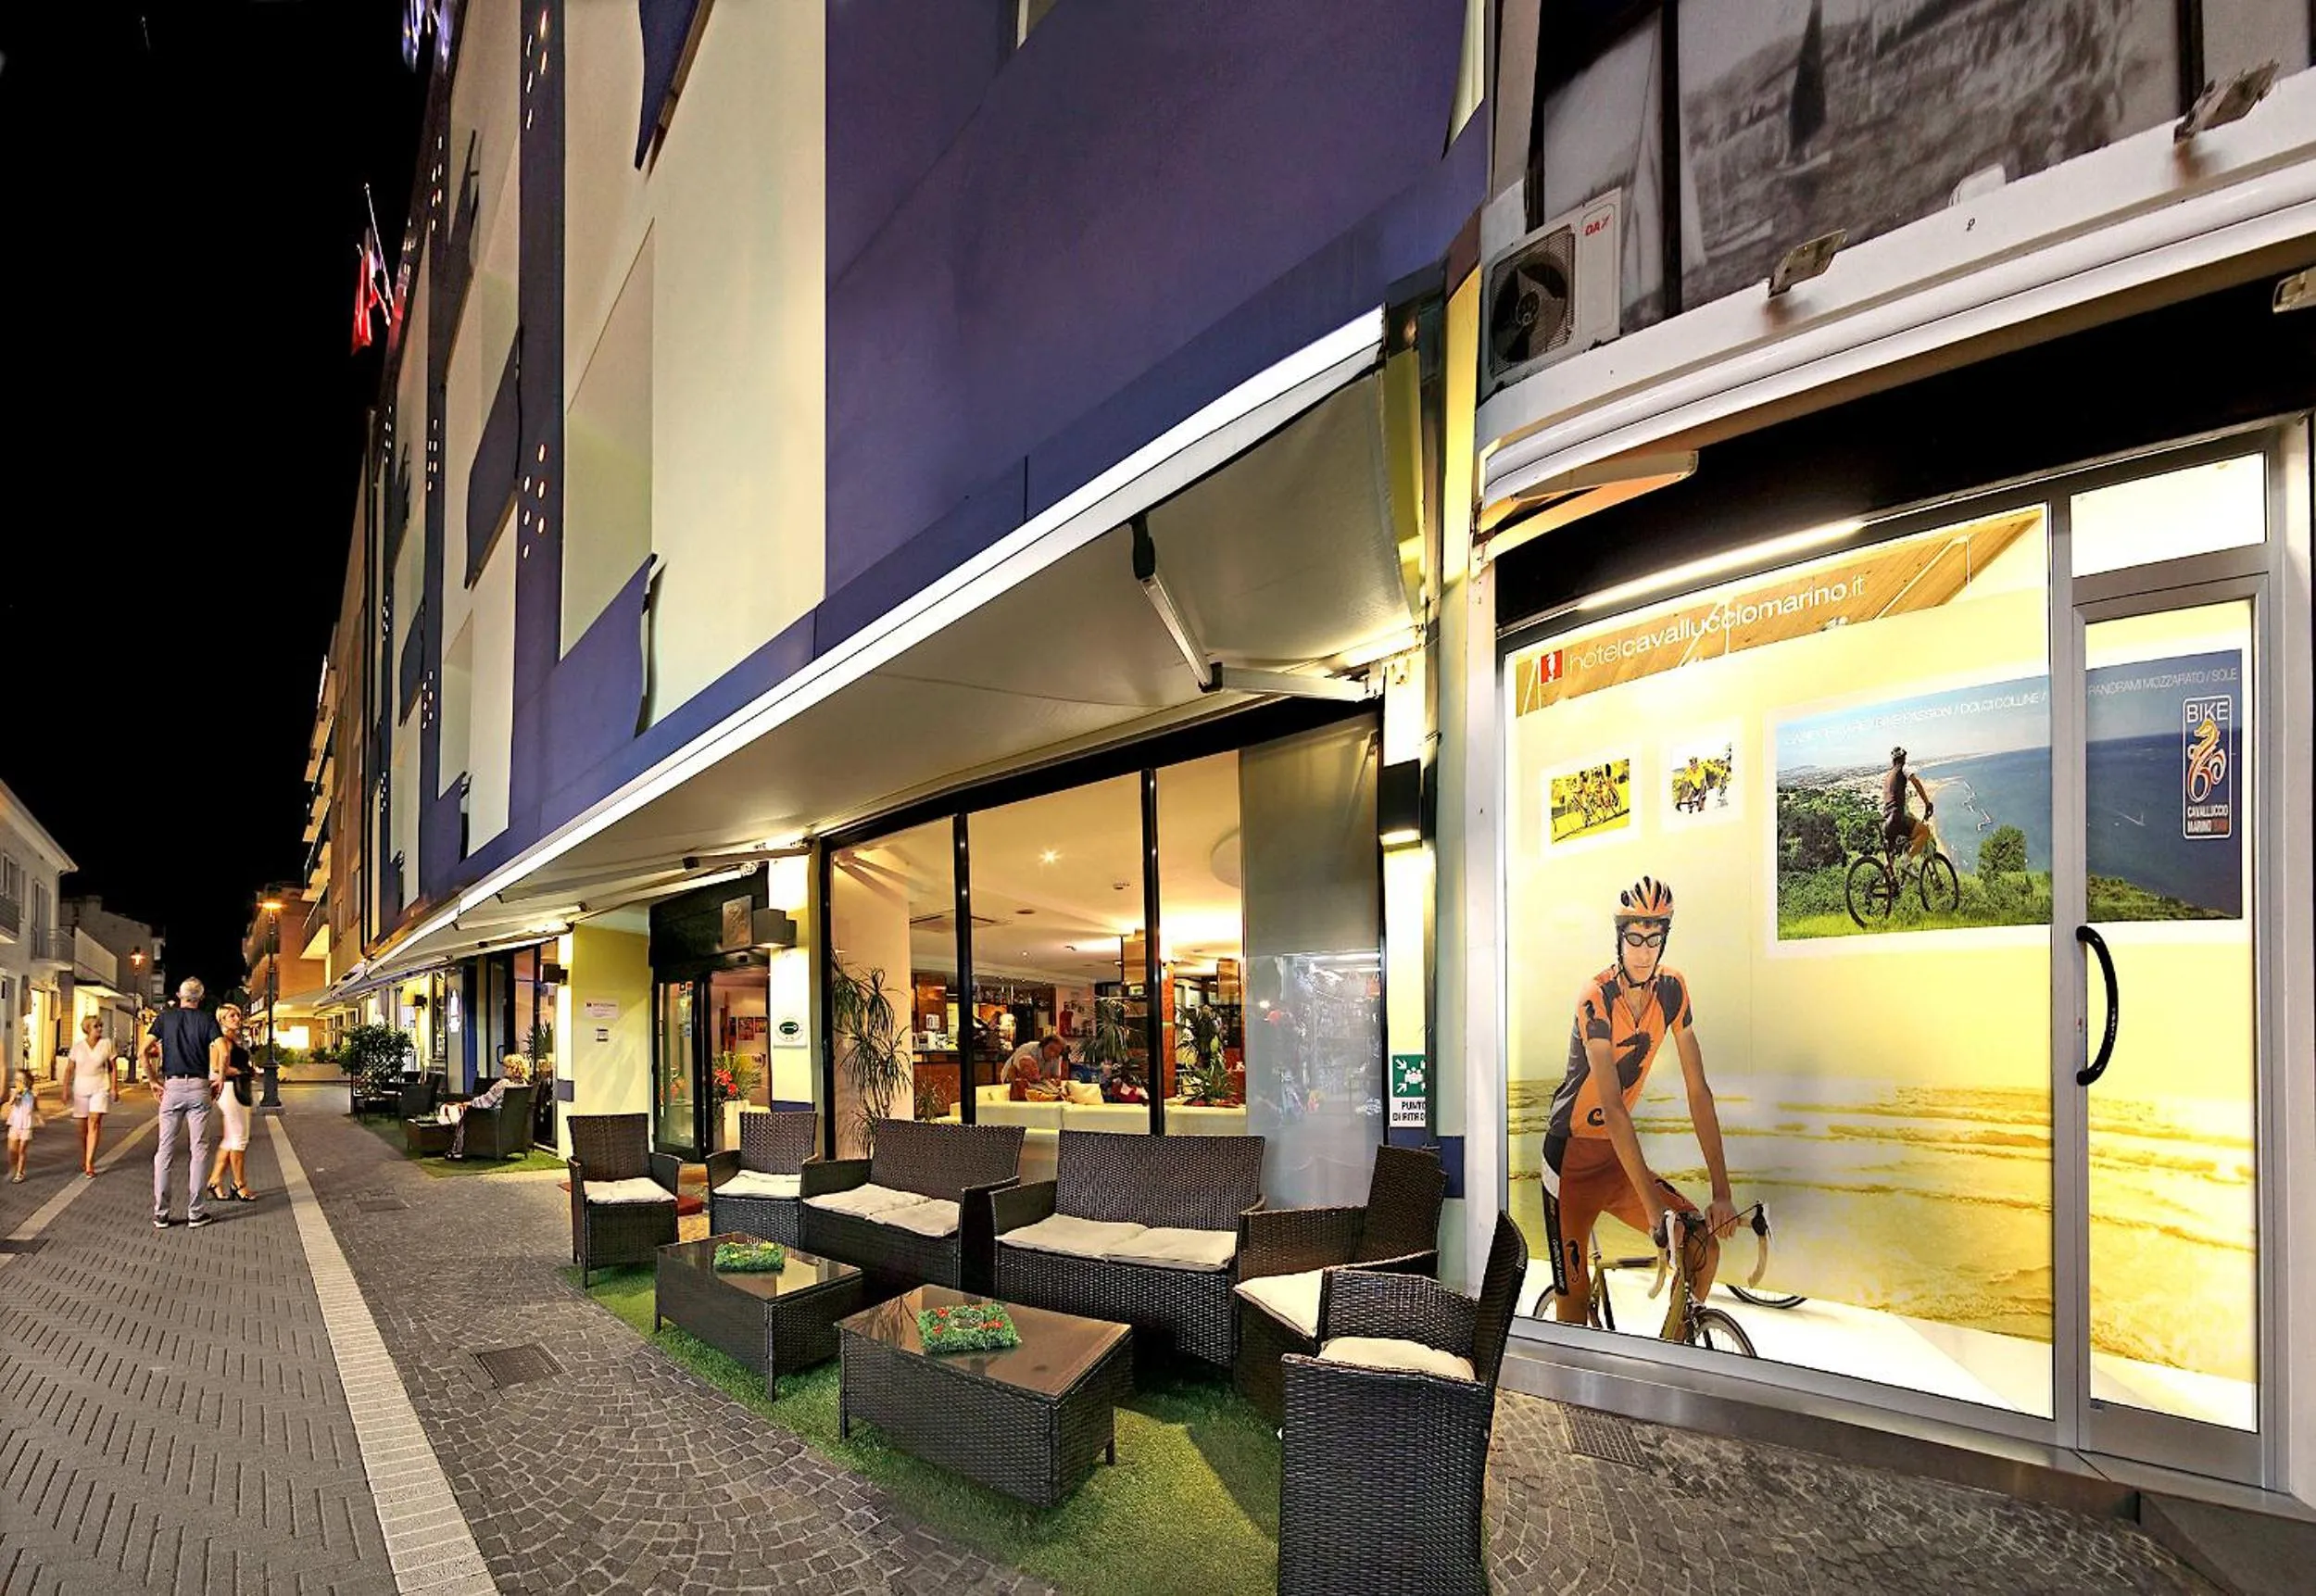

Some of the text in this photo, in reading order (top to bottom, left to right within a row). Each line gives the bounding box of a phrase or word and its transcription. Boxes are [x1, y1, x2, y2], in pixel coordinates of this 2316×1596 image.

[1568, 575, 1865, 674] hotelcavallucciomarino.it
[2211, 667, 2237, 682] SOLE
[2186, 701, 2229, 723] BIKE
